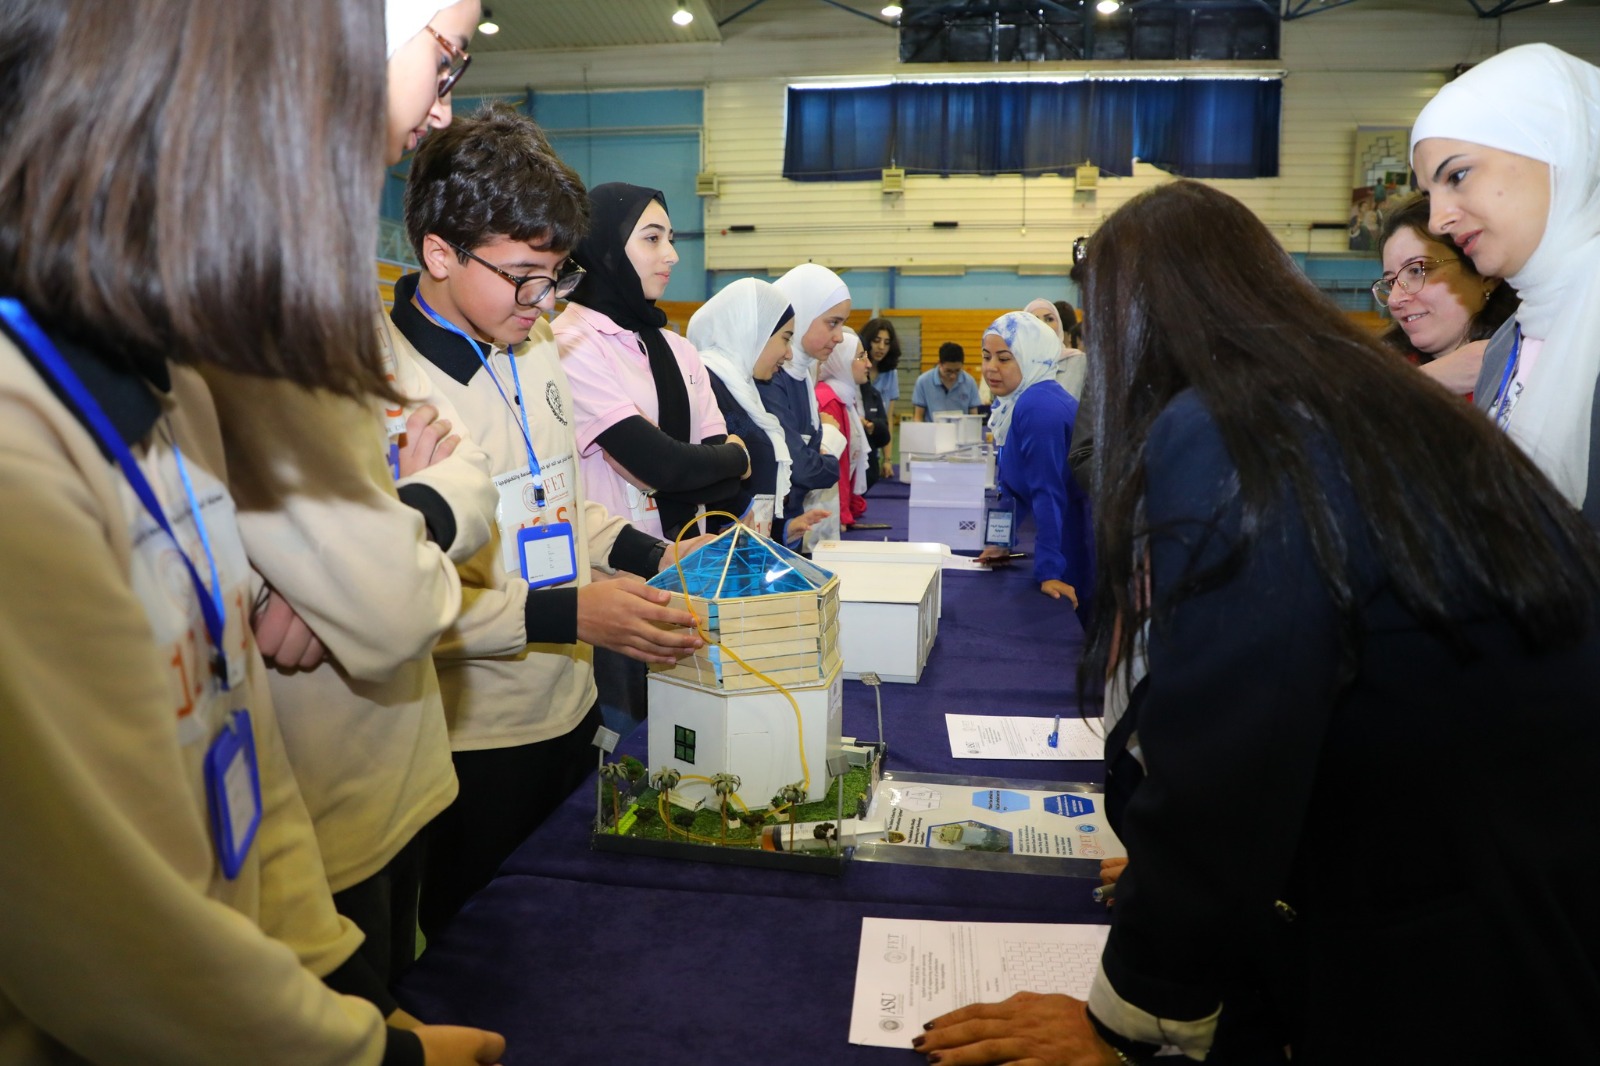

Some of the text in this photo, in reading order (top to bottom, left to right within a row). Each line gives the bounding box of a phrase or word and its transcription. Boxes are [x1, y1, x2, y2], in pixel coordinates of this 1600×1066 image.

[543, 472, 566, 494] FET
[888, 933, 900, 949] FET
[881, 992, 897, 1014] ASU
